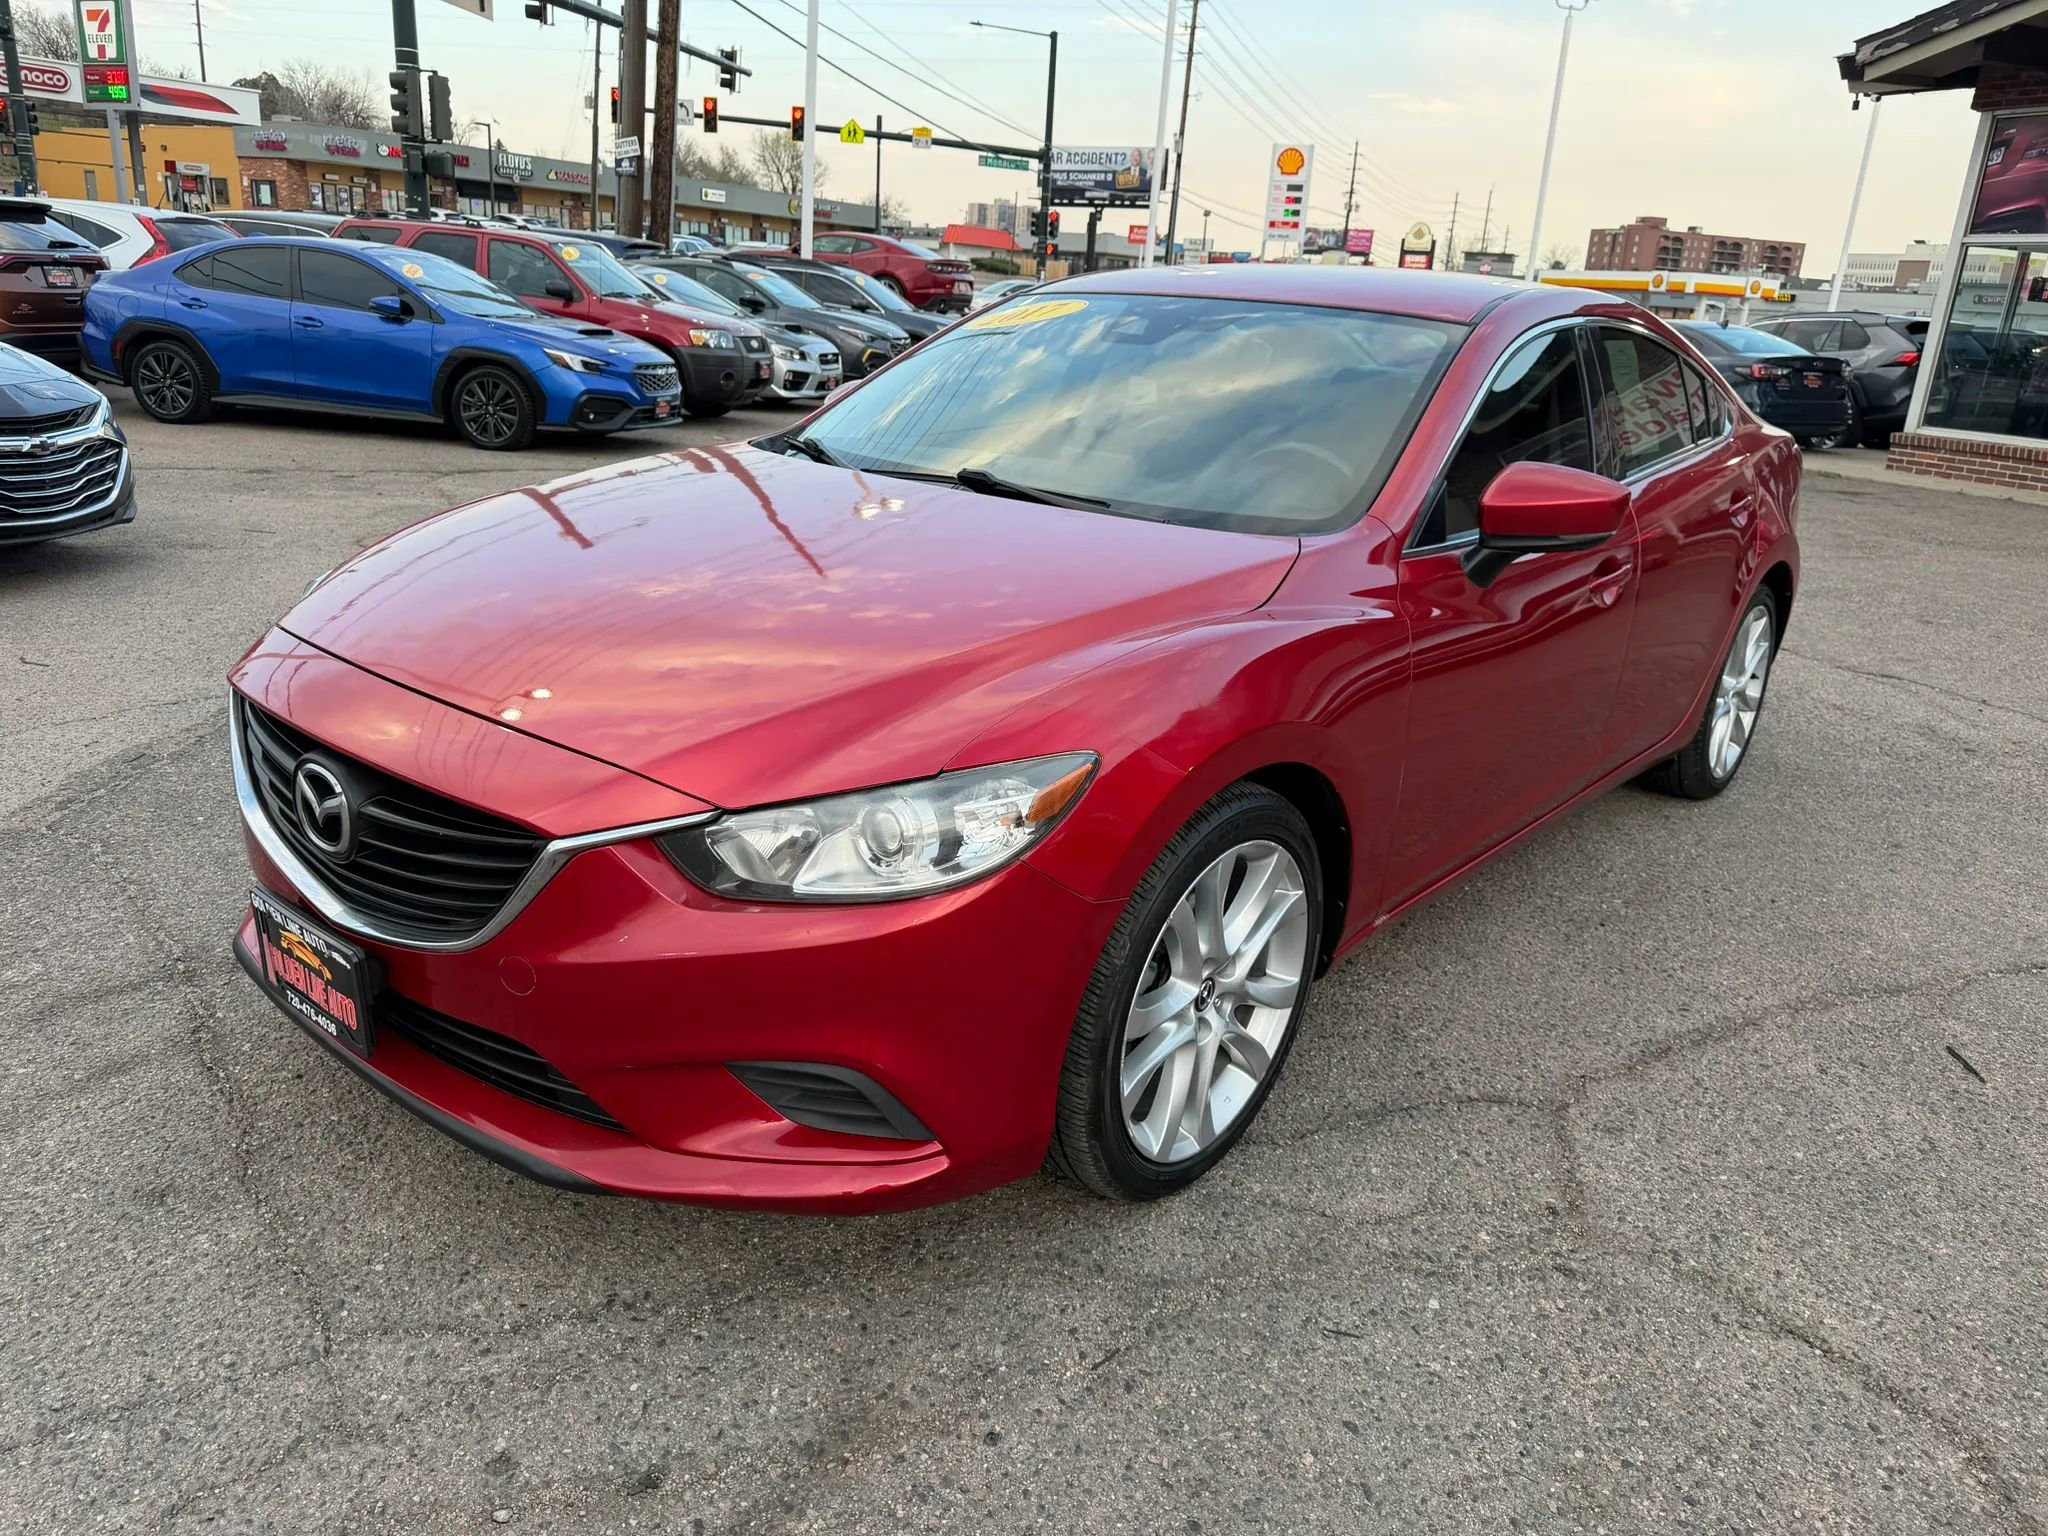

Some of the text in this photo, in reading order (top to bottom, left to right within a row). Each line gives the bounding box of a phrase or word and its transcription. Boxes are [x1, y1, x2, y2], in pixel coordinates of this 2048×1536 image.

[499, 153, 532, 169] FLOYD'S
[1050, 152, 1127, 165] AR ACCIDENT?
[303, 930, 327, 953] AUTO
[328, 985, 357, 1031] AUTO
